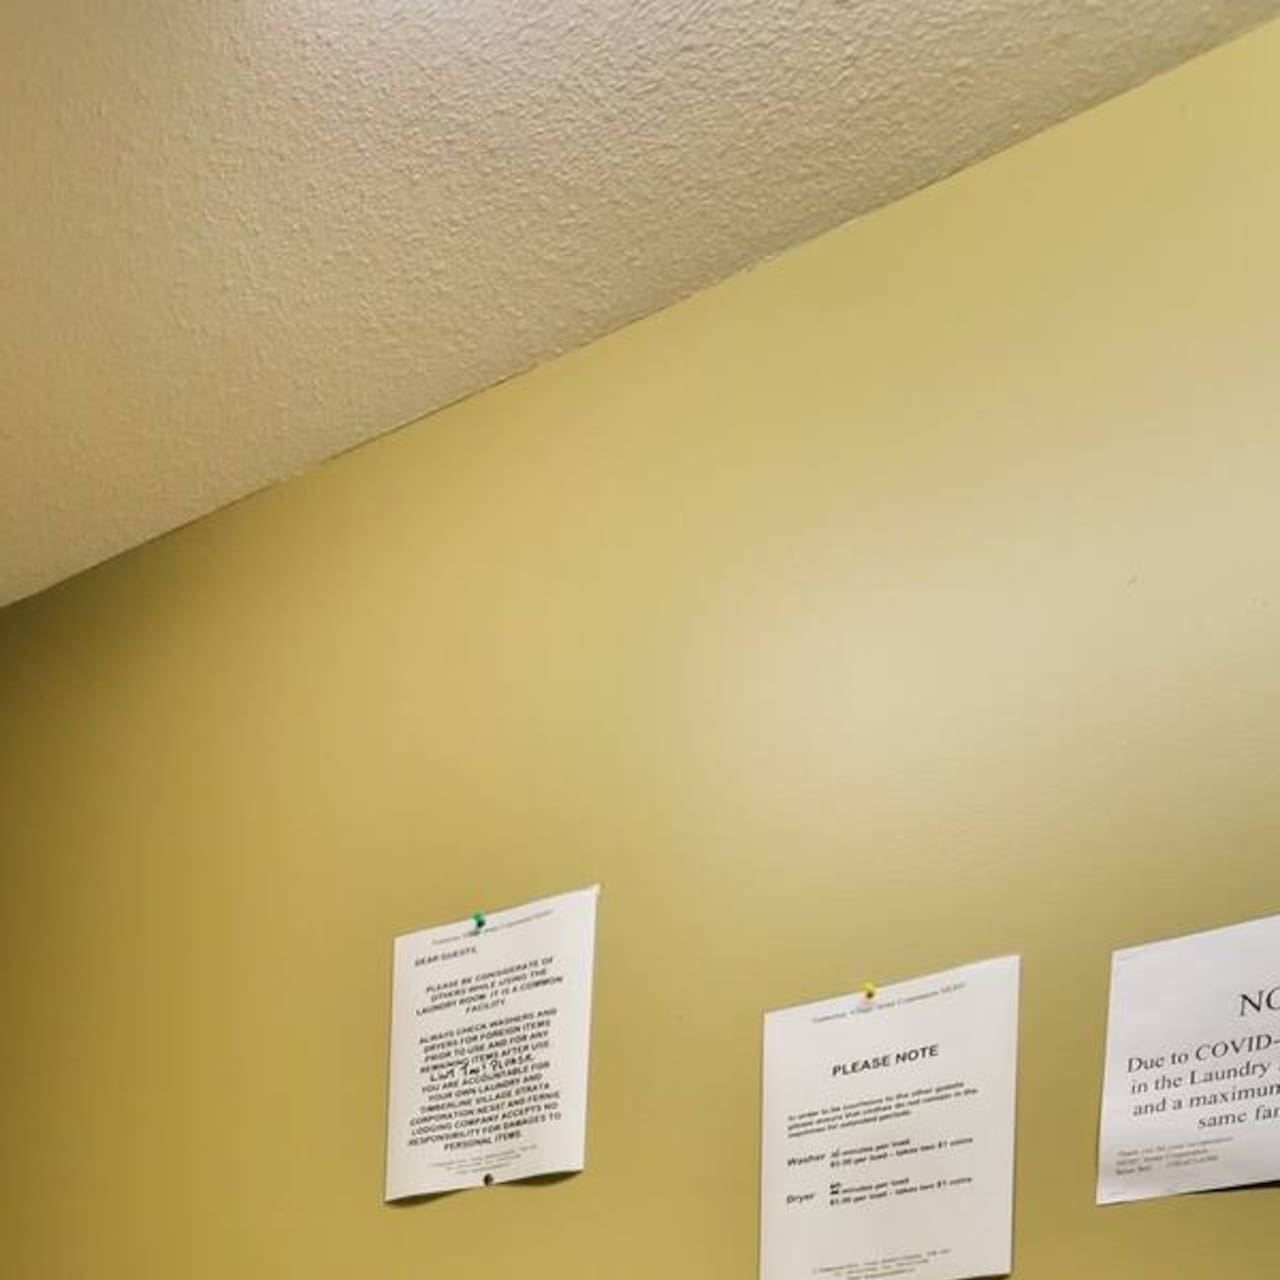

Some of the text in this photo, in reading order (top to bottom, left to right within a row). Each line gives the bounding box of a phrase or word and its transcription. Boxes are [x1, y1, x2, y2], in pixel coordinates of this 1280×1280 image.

[426, 979, 458, 993] PLEASE
[475, 959, 537, 981] CONSIDERATE
[499, 972, 526, 986] USING
[530, 967, 546, 978] THE
[519, 975, 563, 991] COMMON
[419, 1007, 557, 1044] ALWAYS CHECK WASHERS AND
[424, 1018, 550, 1052] DRYERS FOR FOREIGN ITEMS
[425, 1029, 548, 1062] PRIOR TO USE AND FOR ANY
[471, 1051, 498, 1062] ITEMS
[501, 1044, 528, 1056] AFTER
[832, 1044, 939, 1077] PLEASE NOTE
[1128, 1057, 1165, 1073] Due
[1171, 1052, 1189, 1065] to
[422, 1060, 550, 1093] YOU ARE ACCOUNTABLE FOR
[428, 1072, 542, 1102] YOUR OWN LAUNDRY AND
[1131, 1060, 1272, 1094] in the Laundry
[454, 1113, 498, 1128] COMPANY
[501, 1104, 541, 1119] ACCEPTS
[543, 1101, 557, 1110] NO
[548, 1111, 561, 1121] TO
[1133, 1097, 1166, 1116] and
[1172, 1099, 1182, 1110] a
[1198, 1111, 1247, 1130] same
[787, 1152, 825, 1166] Washer
[786, 1192, 815, 1205] Dryer
